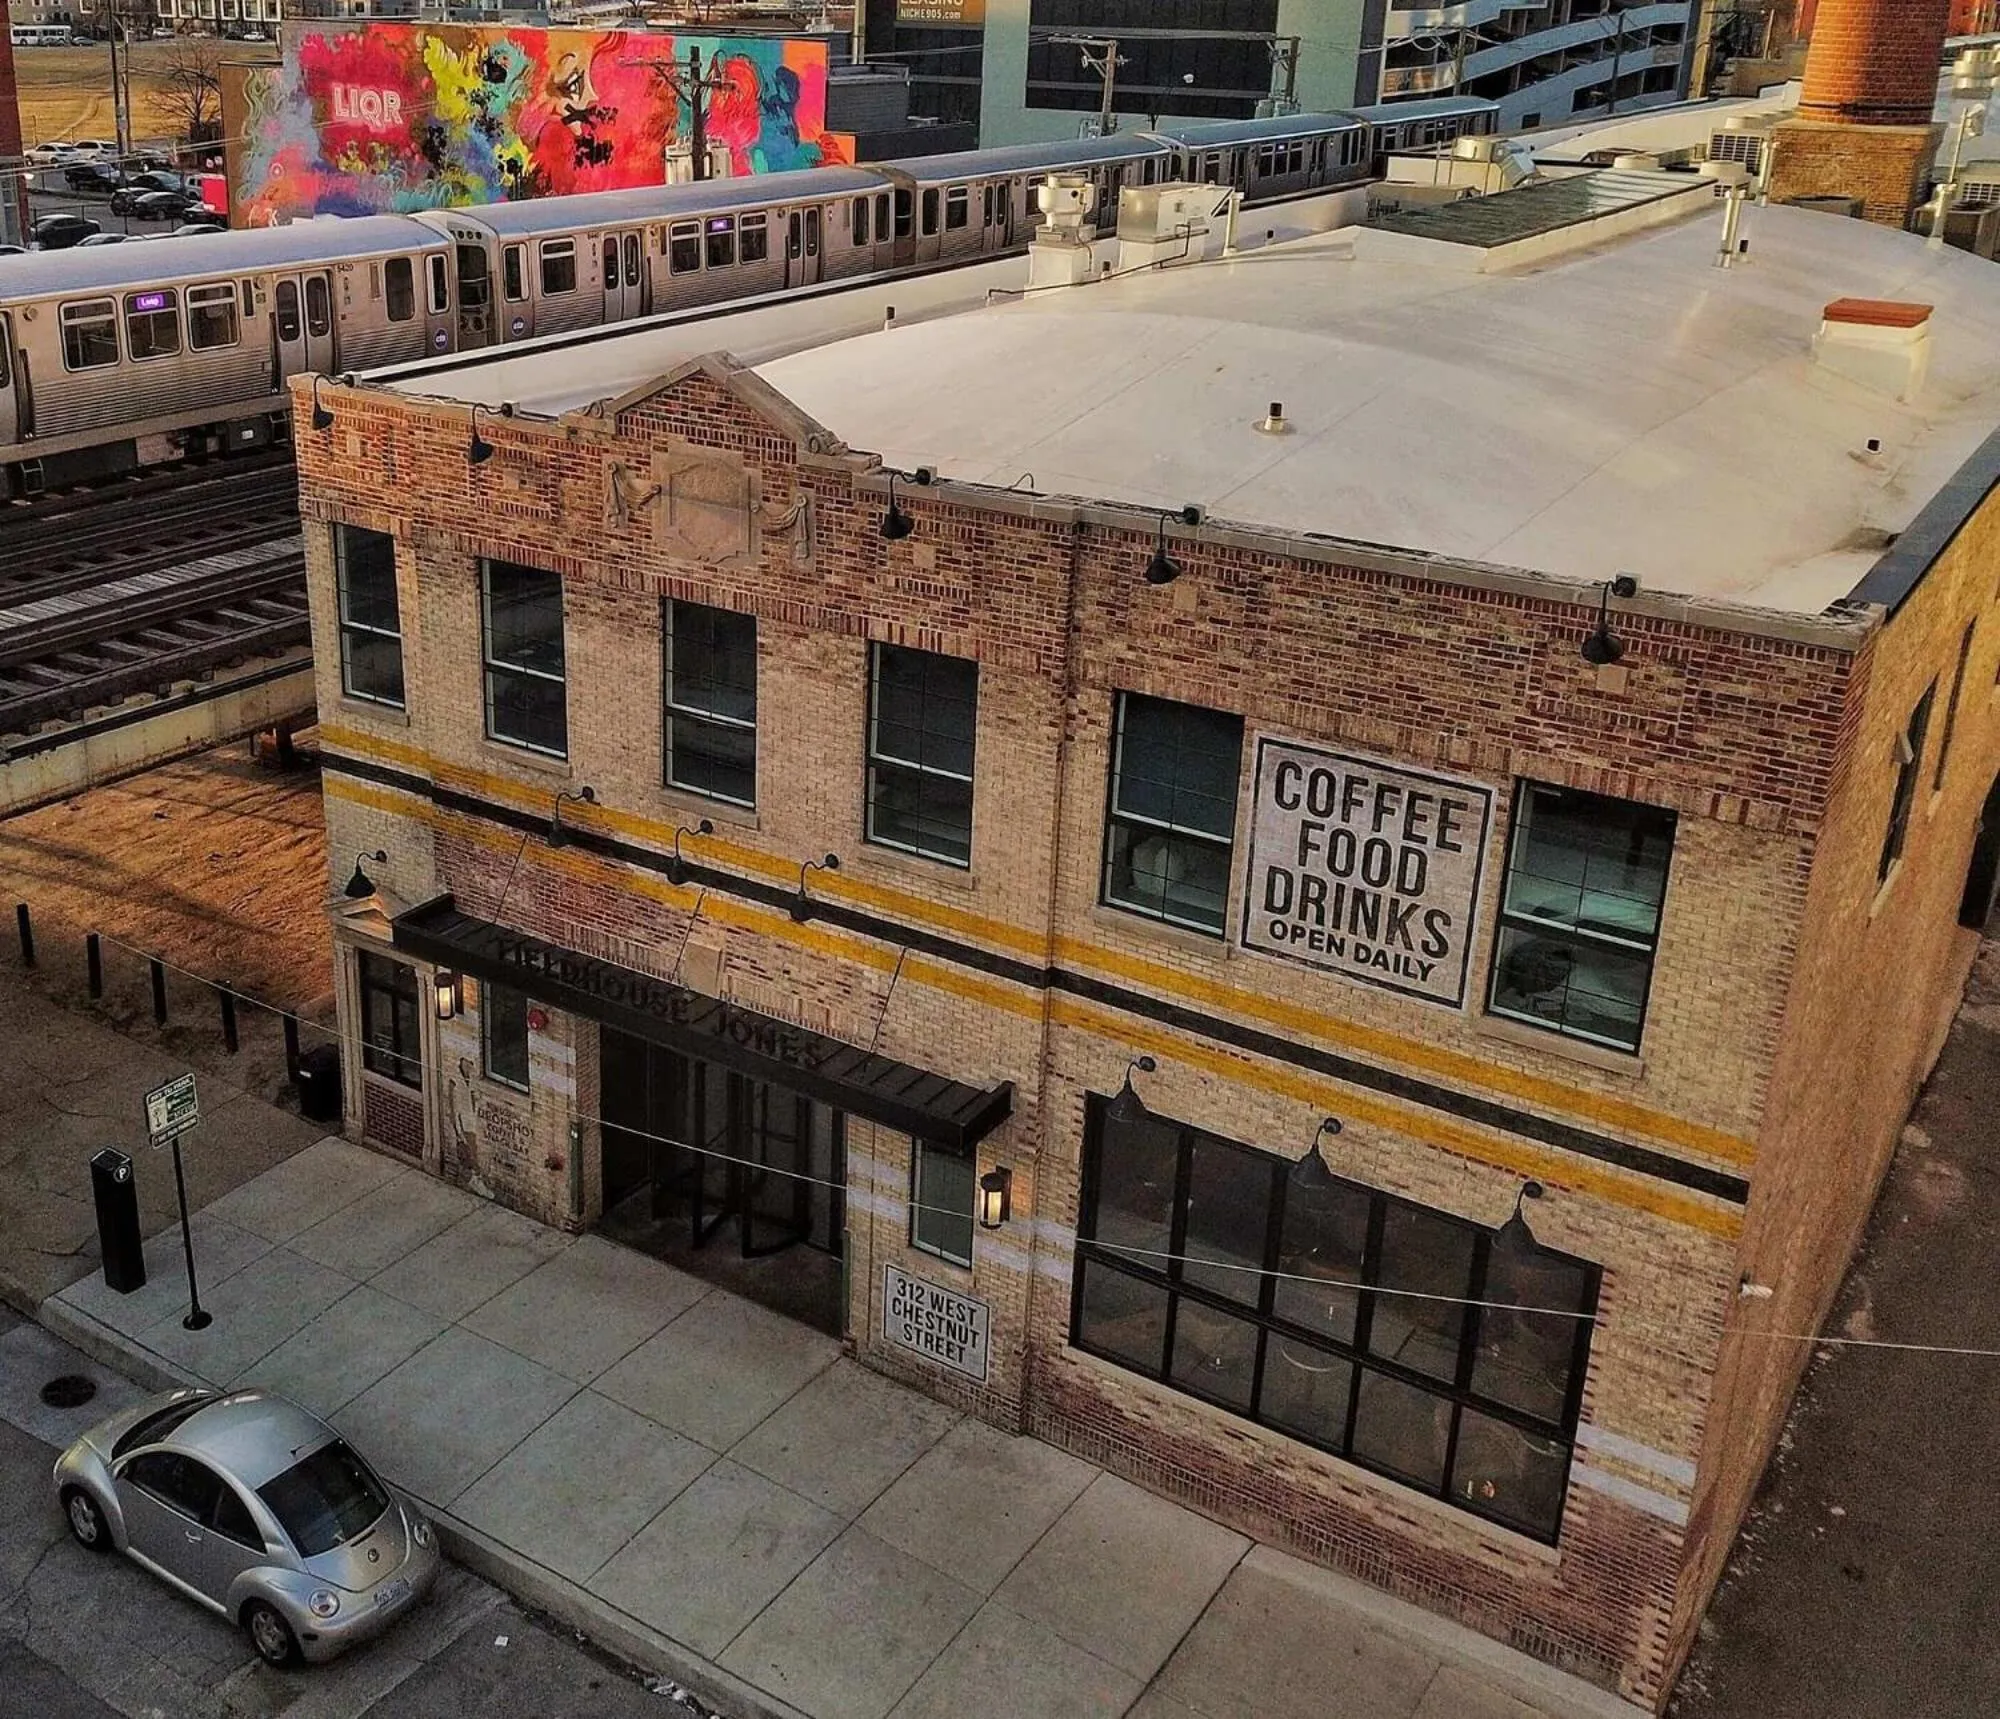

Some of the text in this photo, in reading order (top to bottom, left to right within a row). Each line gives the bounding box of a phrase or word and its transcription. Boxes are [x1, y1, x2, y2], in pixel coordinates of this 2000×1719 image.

[333, 85, 404, 129] LIQR
[1274, 760, 1469, 853] COFFEE
[1298, 819, 1429, 897] FOOD
[1263, 865, 1452, 959] DRINKS
[1268, 919, 1436, 982] OPEN DAILY
[711, 1004, 822, 1070] JONES
[119, 1167, 126, 1179] P
[892, 1297, 980, 1348] CHESTNUT
[896, 1278, 977, 1326] 312 WEST
[903, 1324, 965, 1363] STREET
